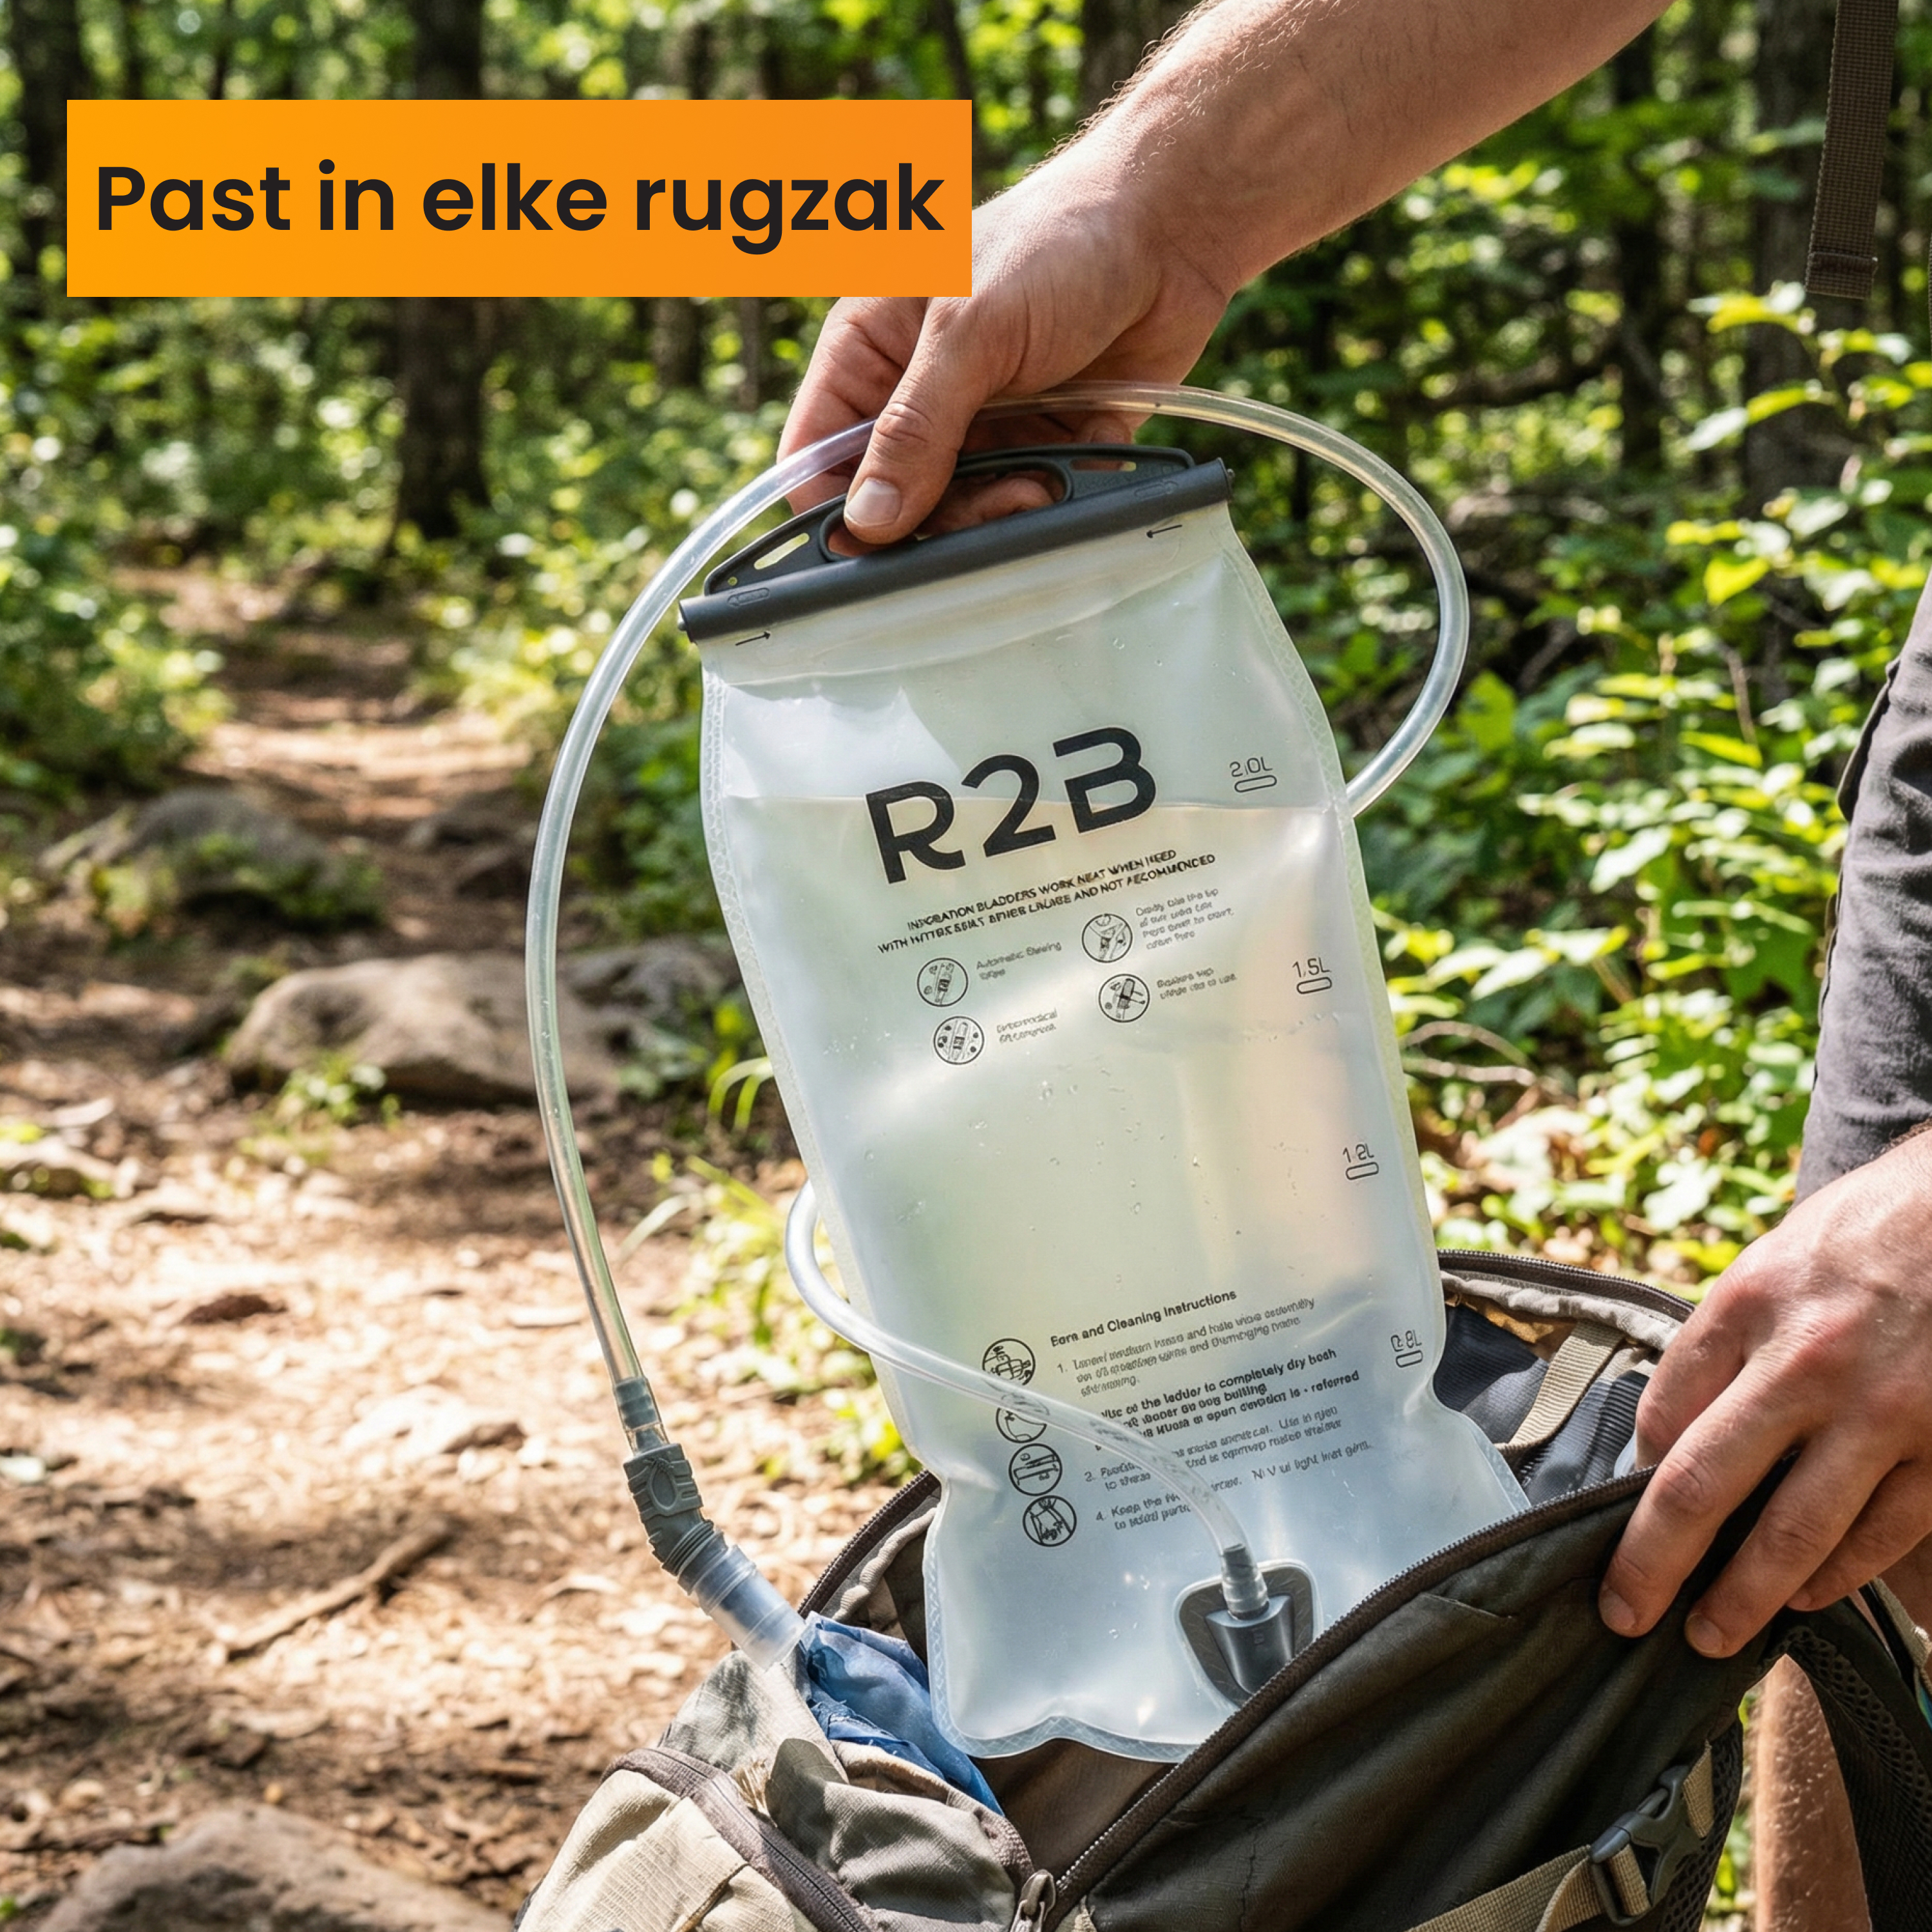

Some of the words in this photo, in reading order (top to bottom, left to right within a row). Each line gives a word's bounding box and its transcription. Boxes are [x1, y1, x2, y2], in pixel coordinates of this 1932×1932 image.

[866, 727, 1156, 884] R2B
[1074, 886, 1099, 902] AND
[1100, 878, 1124, 894] NOT
[1081, 1324, 1104, 1340] and
